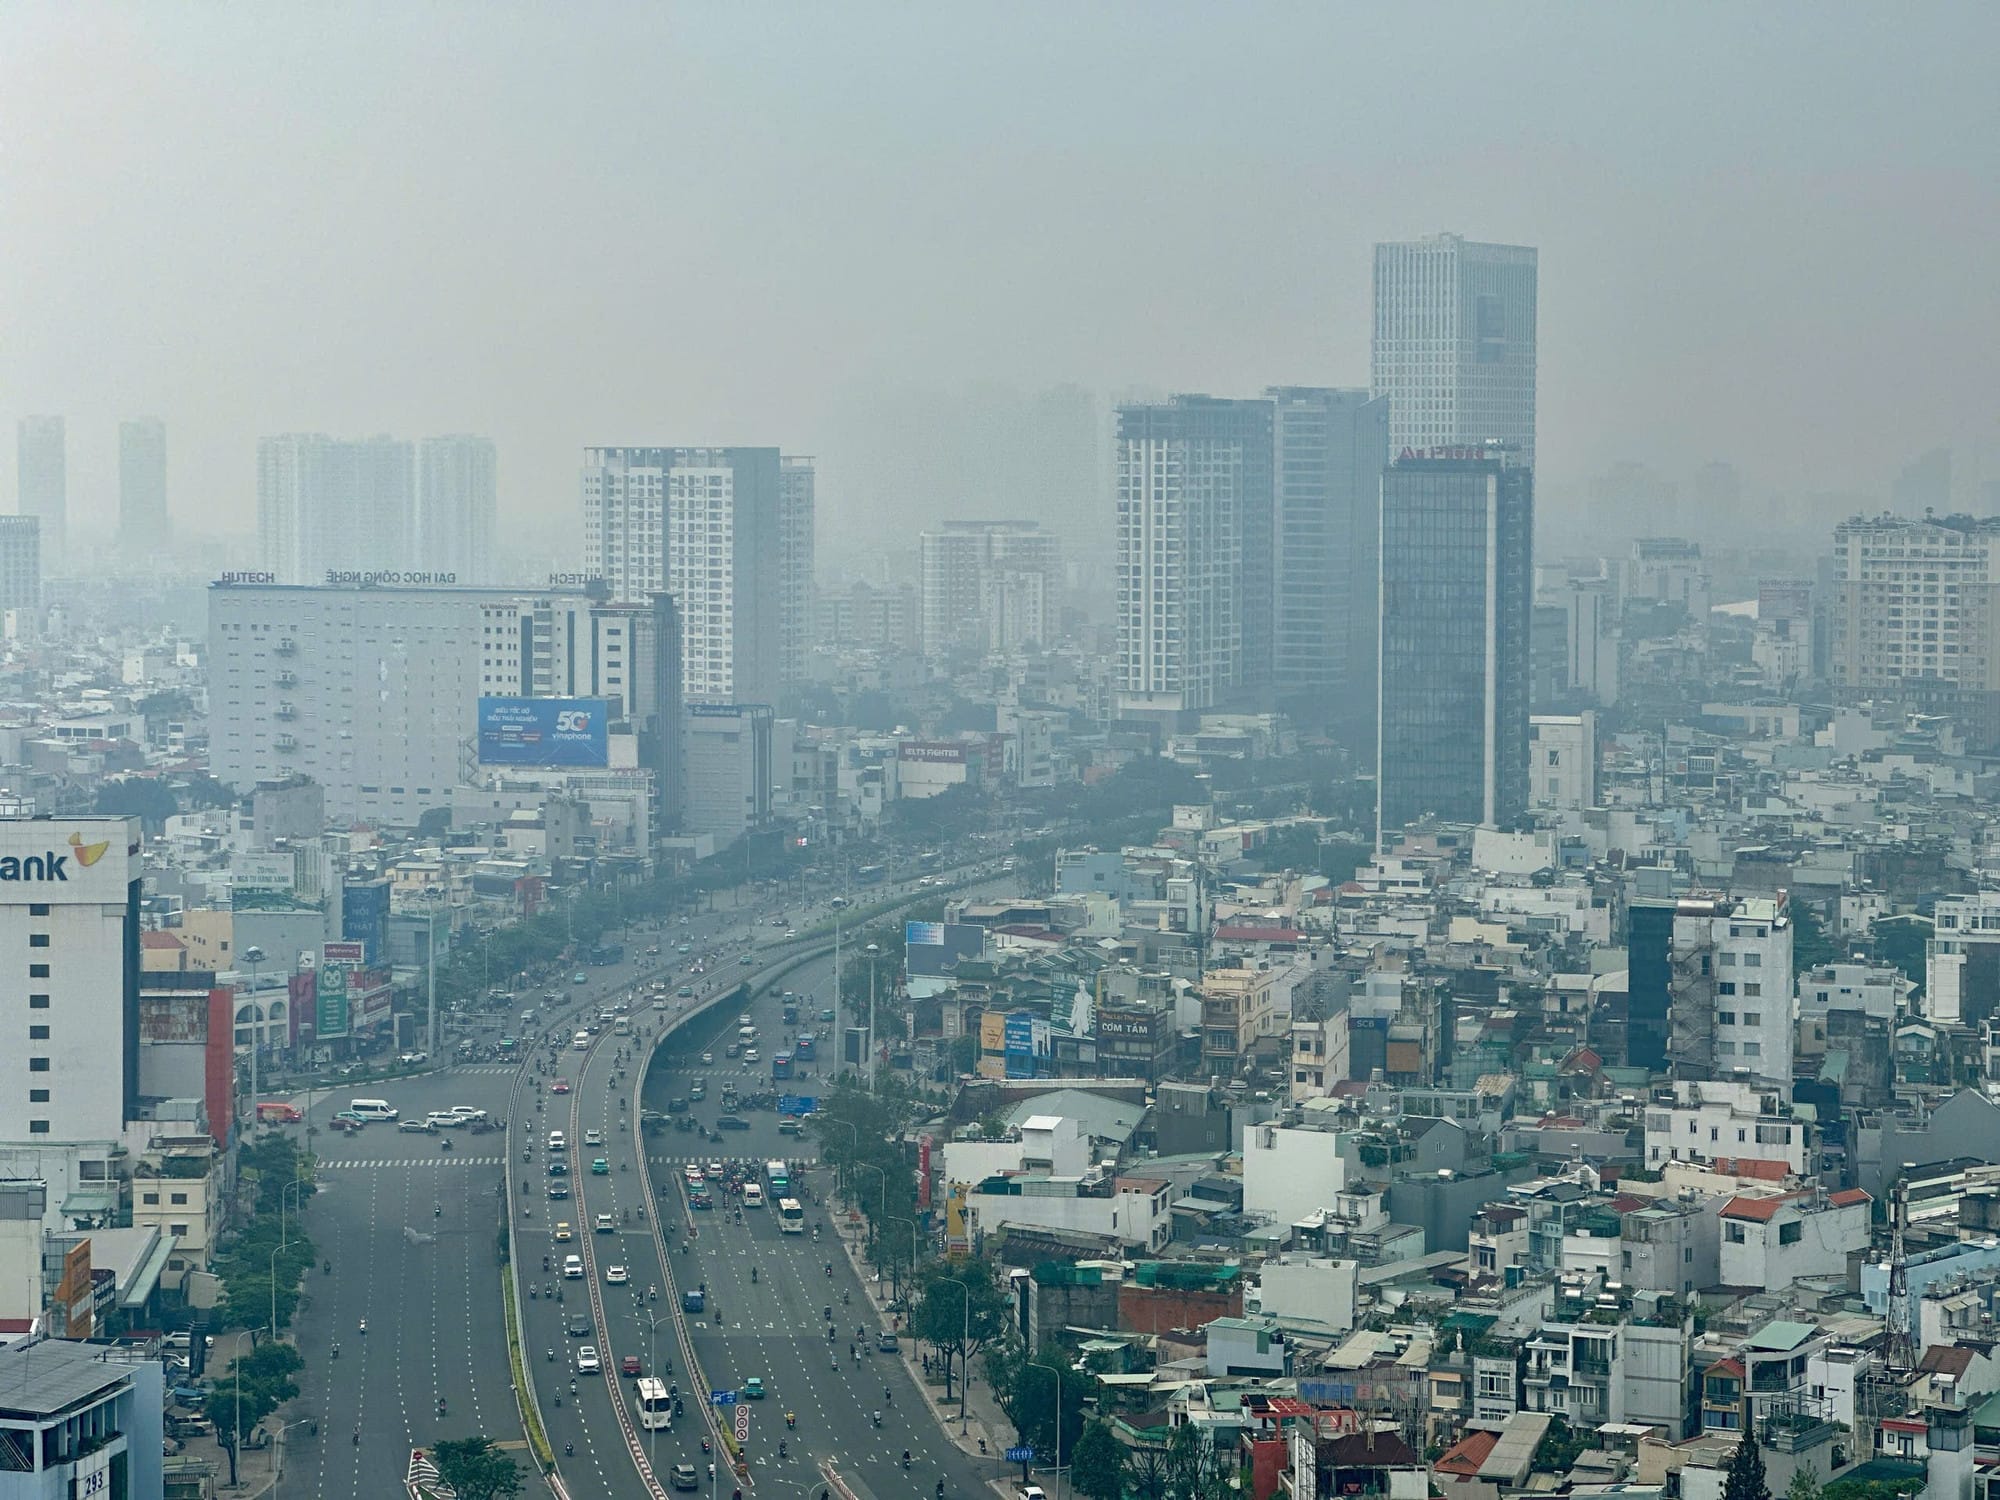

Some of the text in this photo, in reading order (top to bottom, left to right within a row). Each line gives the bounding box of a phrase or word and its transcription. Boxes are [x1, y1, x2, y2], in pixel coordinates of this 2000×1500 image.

[222, 571, 274, 584] HUTECH
[905, 747, 959, 757] IELTS FIGHTER
[1102, 1021, 1148, 1034] CƠM TẤM
[86, 1471, 103, 1495] 293
